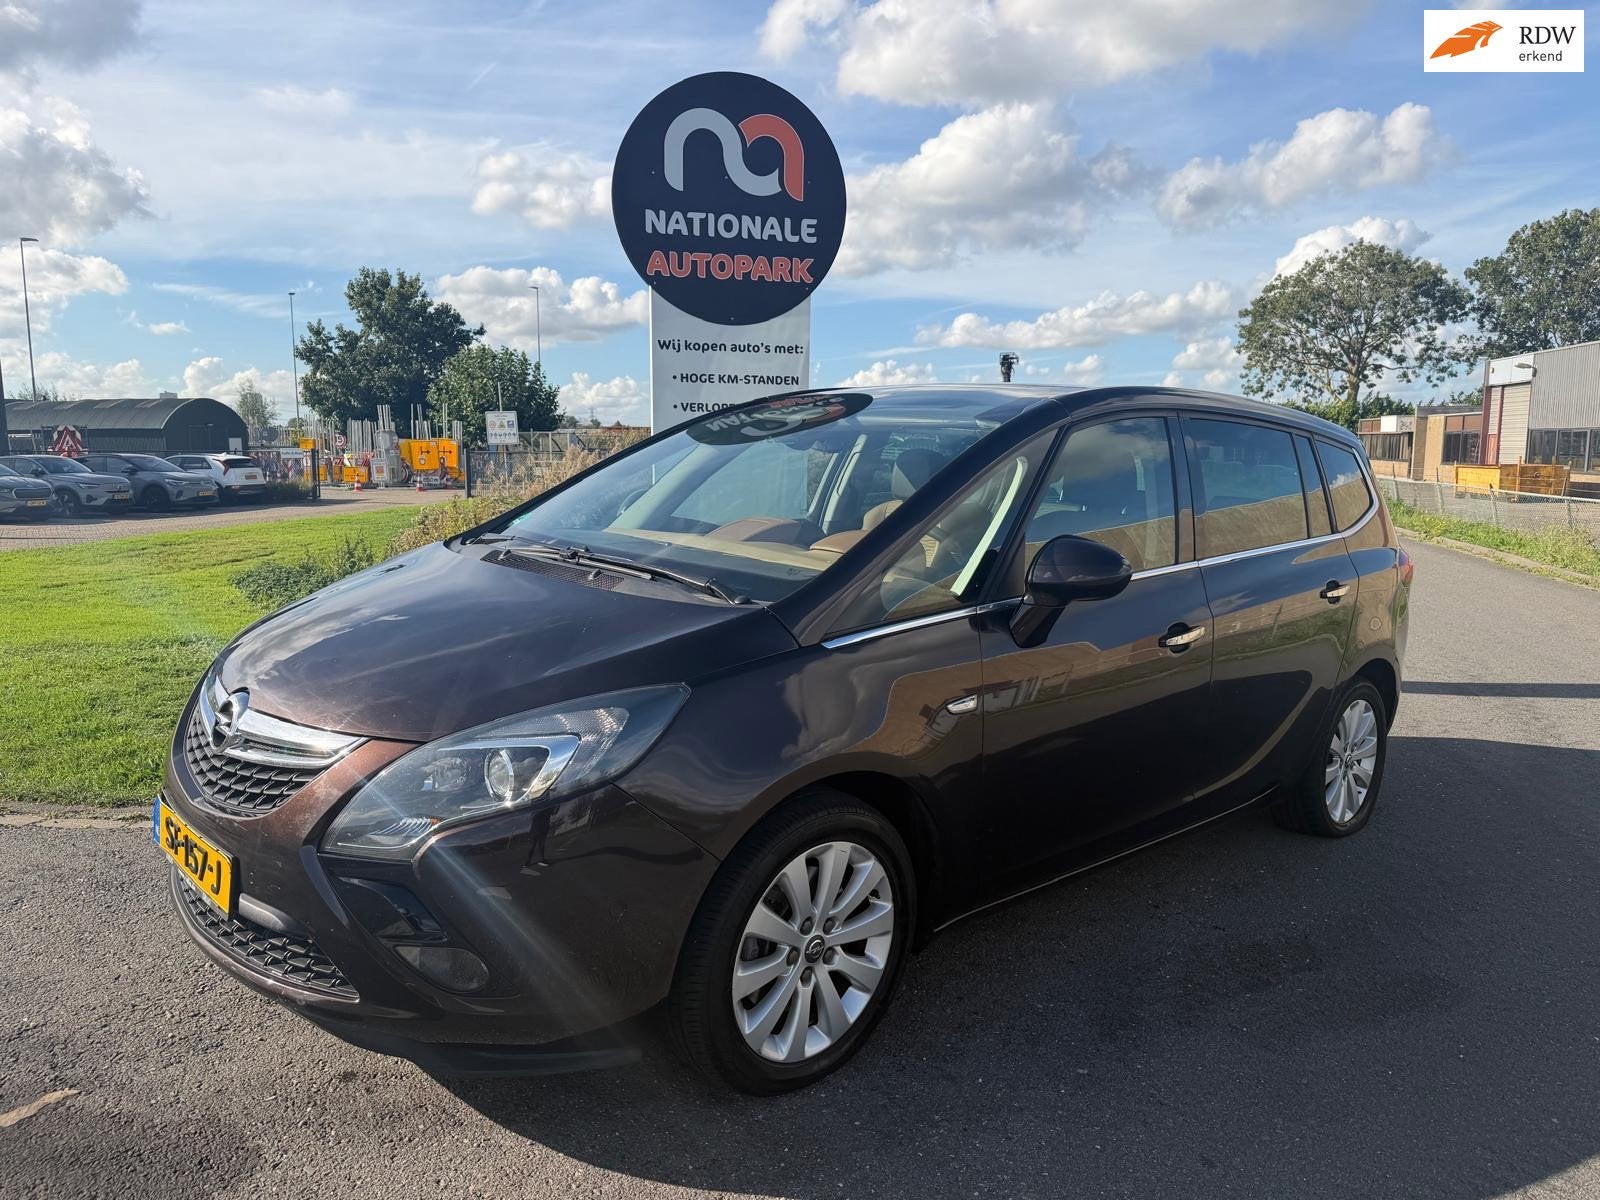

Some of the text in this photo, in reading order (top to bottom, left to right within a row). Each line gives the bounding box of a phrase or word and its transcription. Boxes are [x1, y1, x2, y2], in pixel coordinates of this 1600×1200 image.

[645, 209, 818, 243] NATIONALE
[646, 250, 814, 283] AUTOPARK
[657, 339, 804, 354] Wij kopen auto's met:
[680, 373, 800, 385] HOGE KM-STANDEN
[165, 816, 222, 896] SF-157-J
